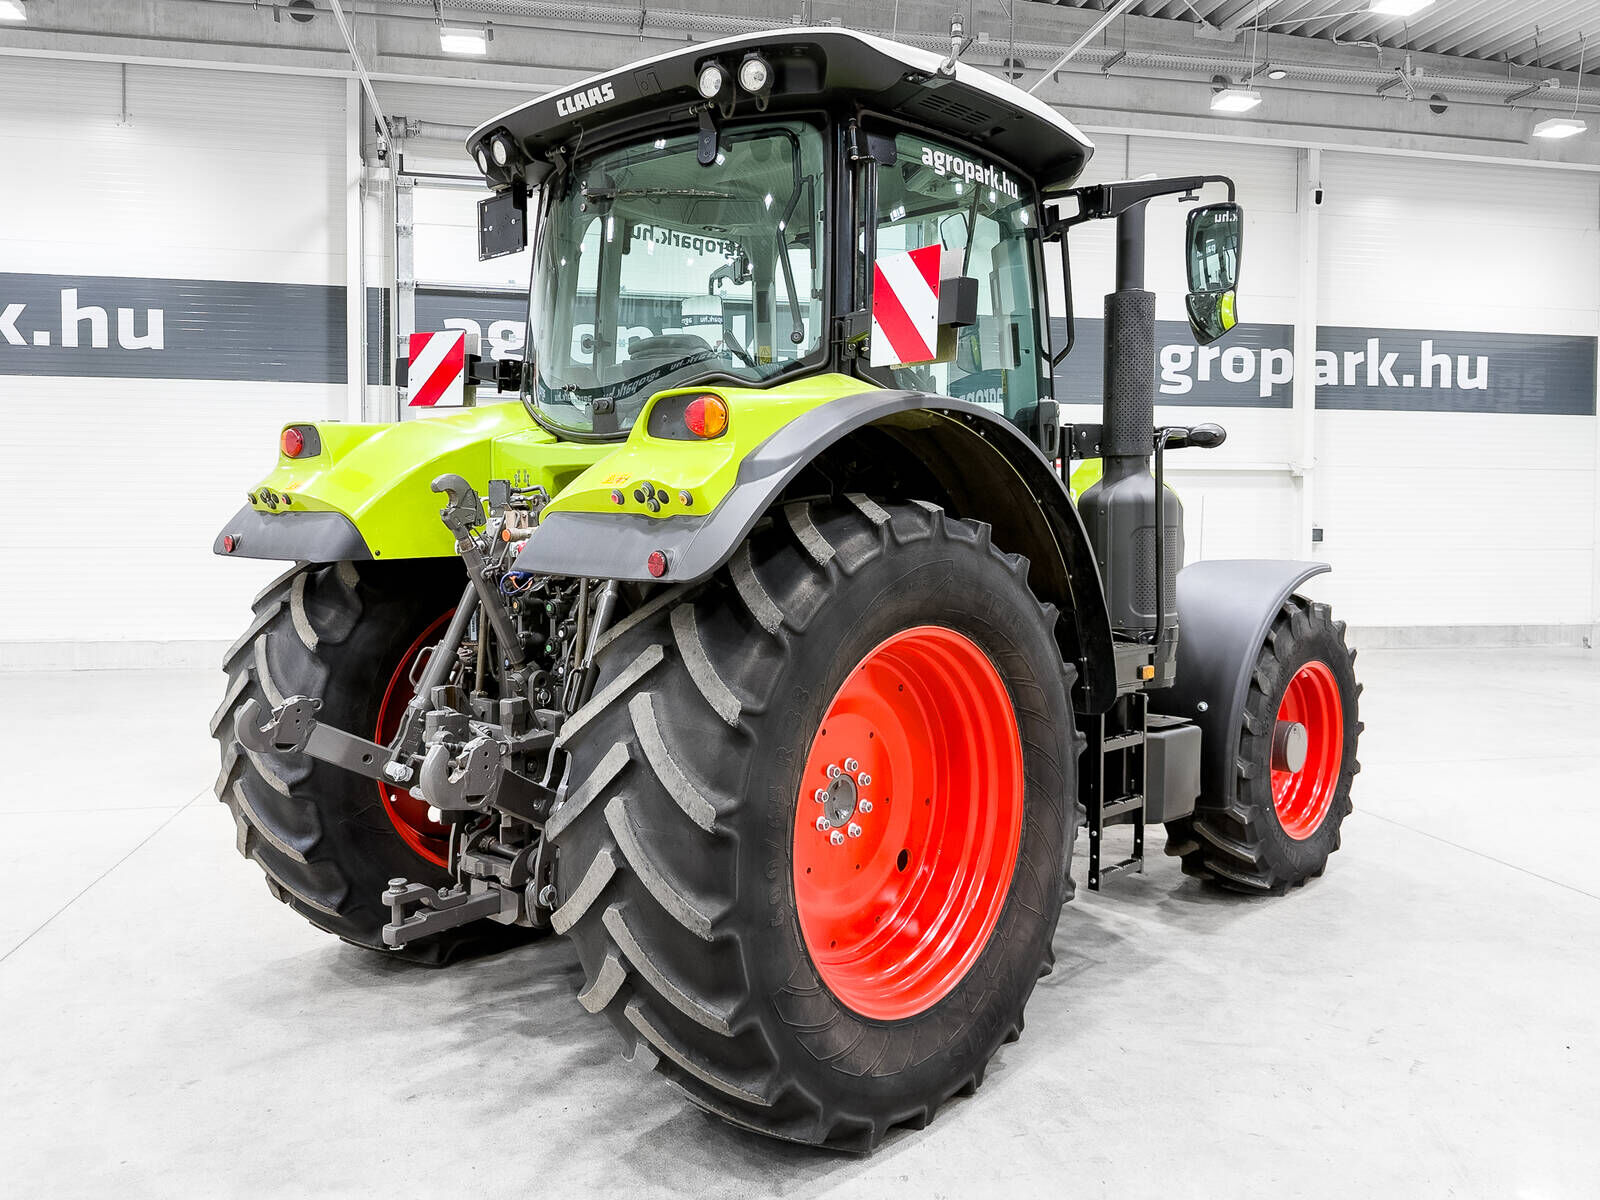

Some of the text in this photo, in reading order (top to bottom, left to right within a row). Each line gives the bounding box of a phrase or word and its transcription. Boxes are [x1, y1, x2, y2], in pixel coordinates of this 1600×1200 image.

[556, 82, 615, 117] CLAAS
[921, 146, 1019, 200] agropark.hu
[1158, 337, 1489, 398] gropark.hu
